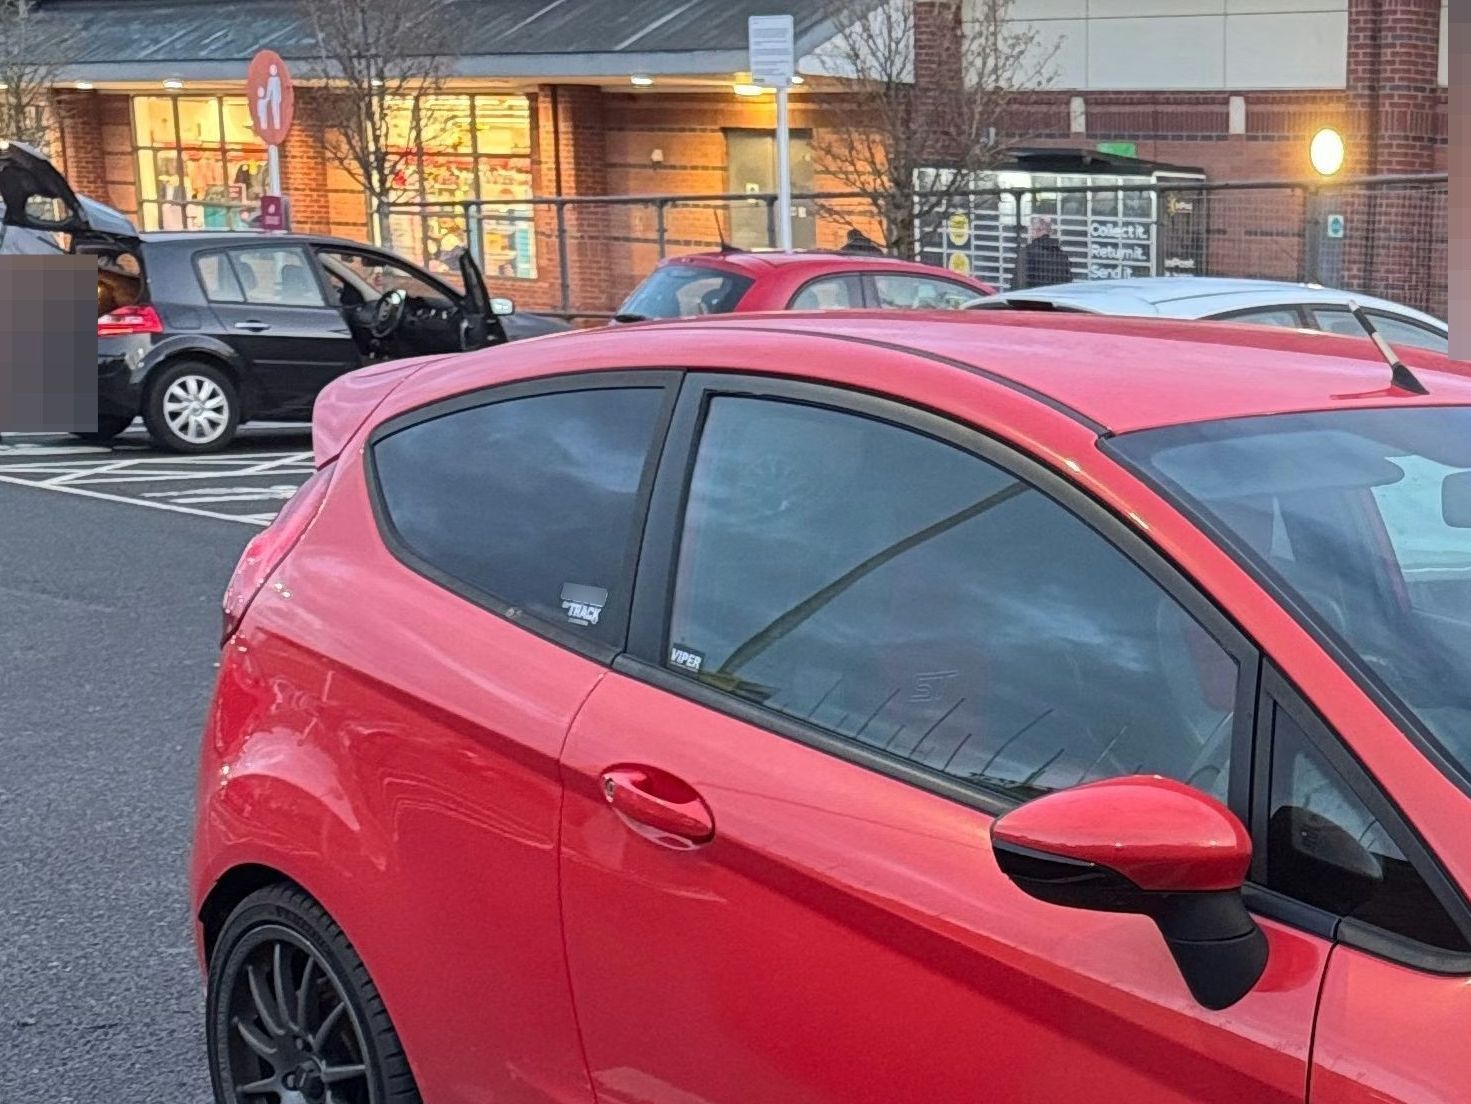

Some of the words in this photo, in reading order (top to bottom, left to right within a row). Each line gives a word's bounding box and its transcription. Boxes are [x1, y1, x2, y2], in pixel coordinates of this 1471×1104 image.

[1090, 222, 1134, 239] Collect
[1090, 244, 1133, 259] Return
[1090, 265, 1120, 279] Send
[670, 647, 702, 670] VIPER
